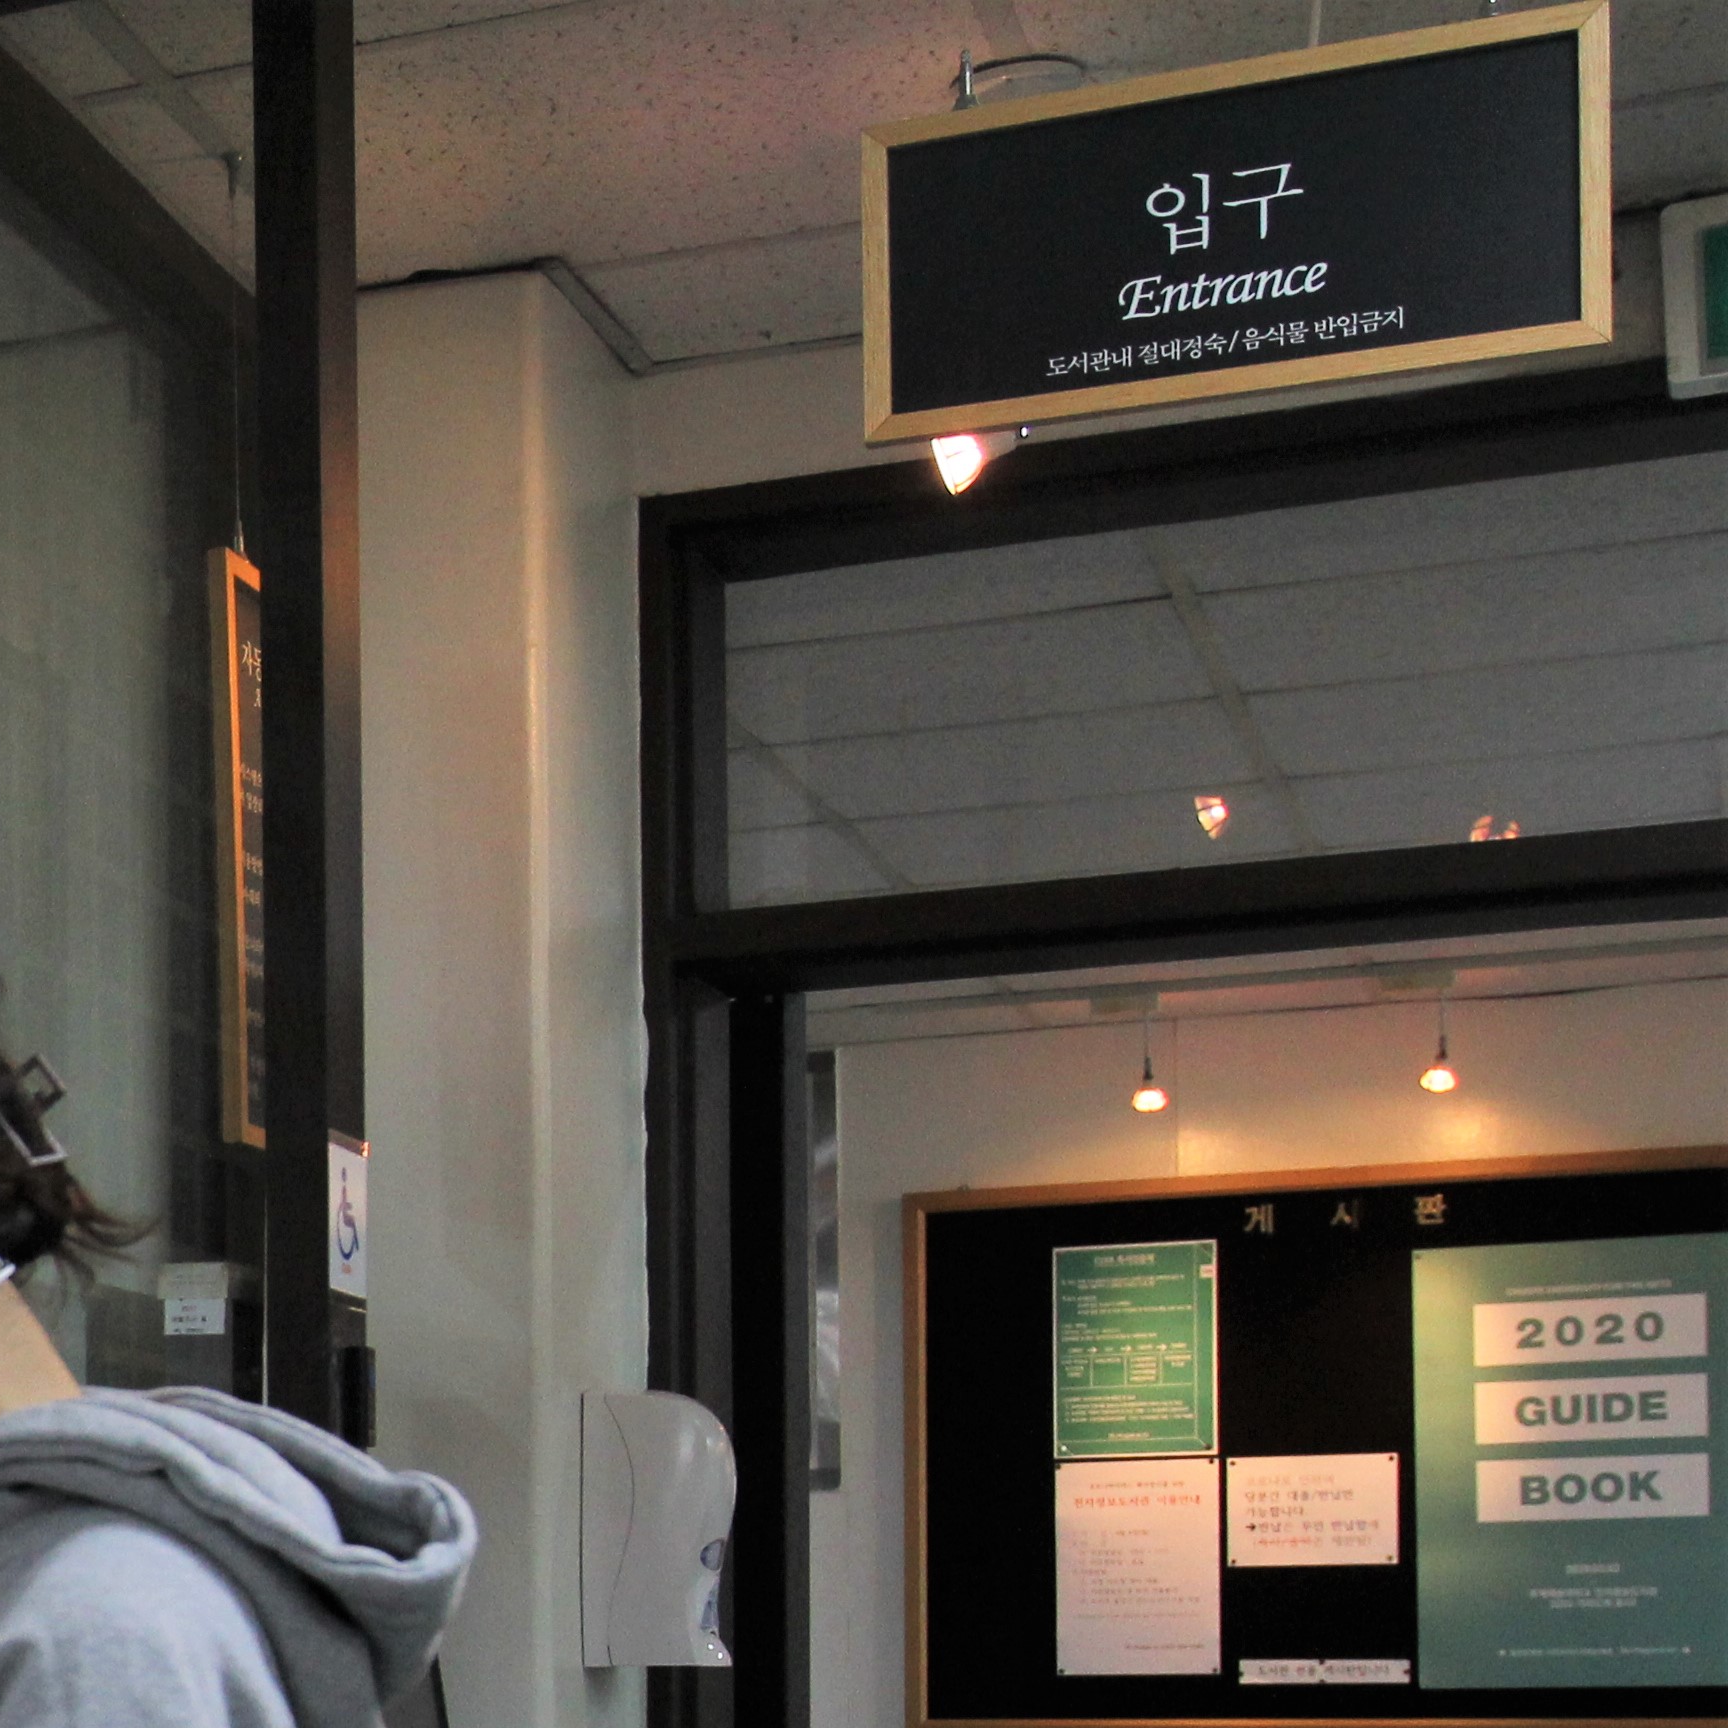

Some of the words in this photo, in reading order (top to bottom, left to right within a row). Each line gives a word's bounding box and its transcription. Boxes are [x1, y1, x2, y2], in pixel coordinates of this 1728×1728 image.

[1146, 162, 1304, 257] 입구
[1118, 261, 1327, 321] Entrance
[1045, 346, 1133, 377] 도서관내
[1313, 305, 1405, 340] 반입금지
[1516, 1311, 1665, 1349] 2020
[1515, 1389, 1668, 1427] GUIDE
[1519, 1468, 1663, 1507] BOOK
